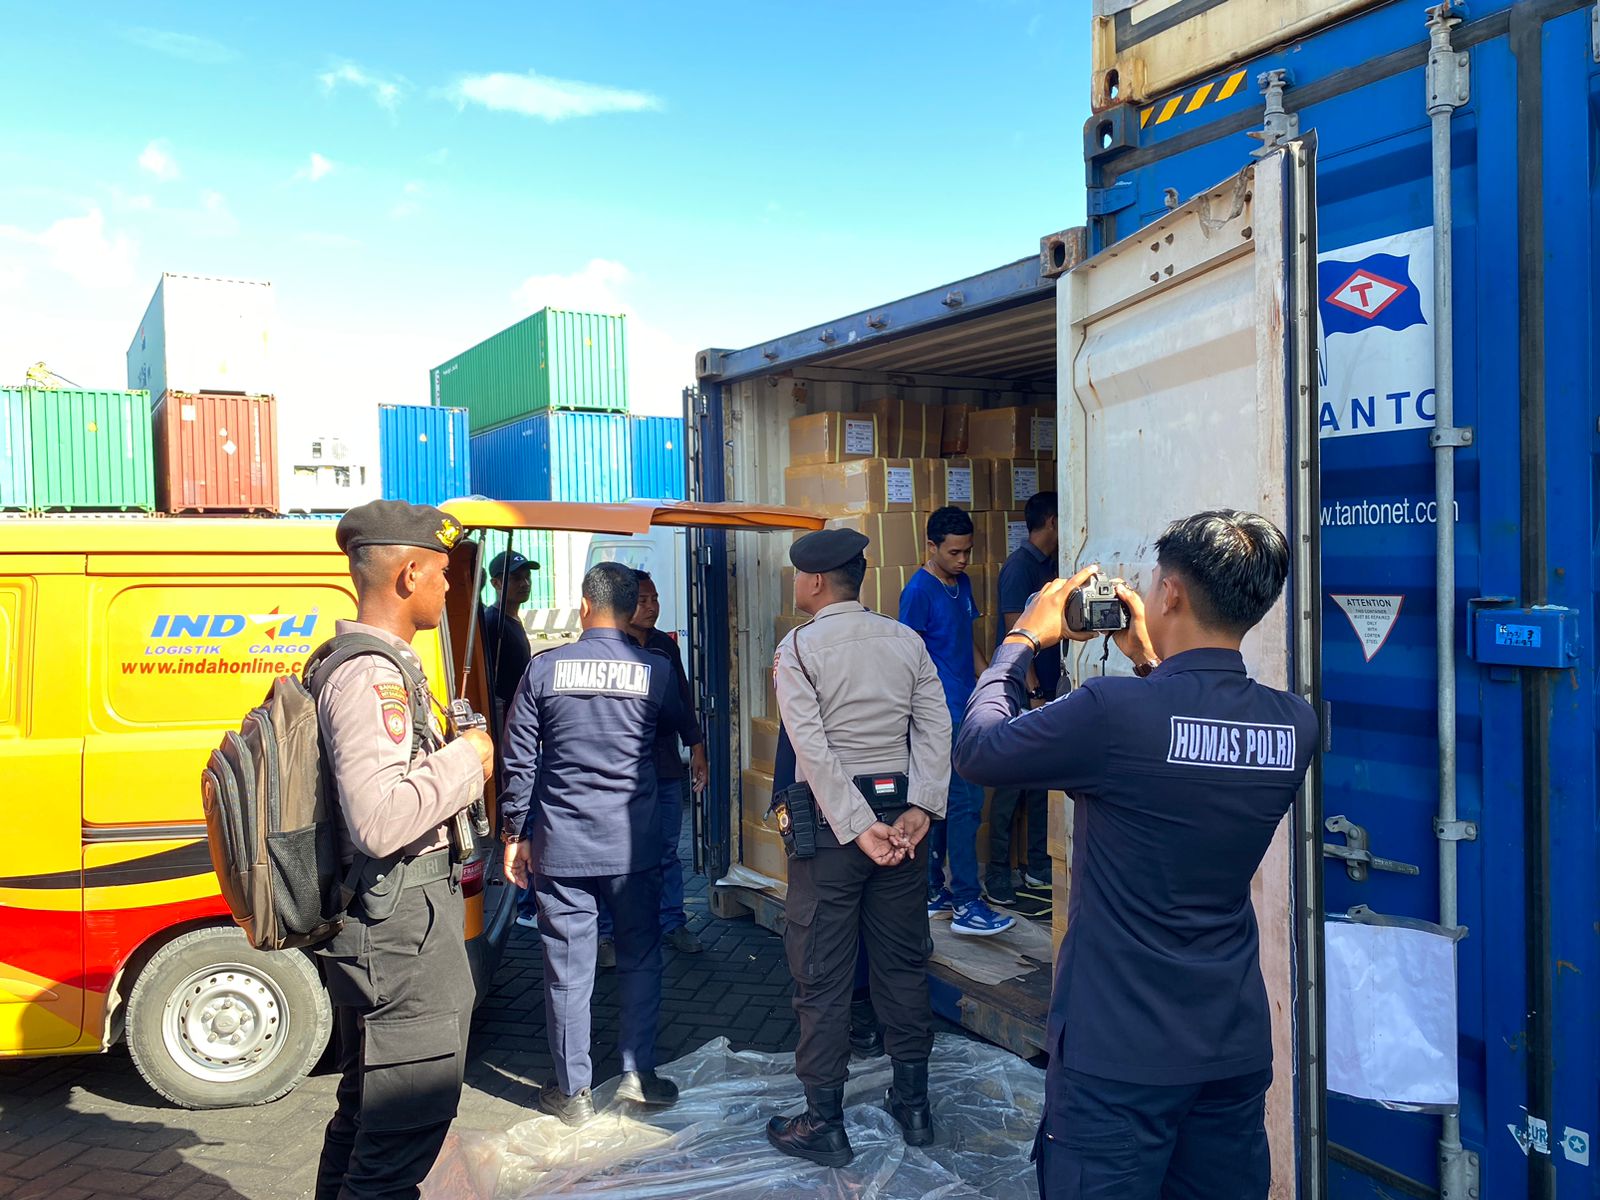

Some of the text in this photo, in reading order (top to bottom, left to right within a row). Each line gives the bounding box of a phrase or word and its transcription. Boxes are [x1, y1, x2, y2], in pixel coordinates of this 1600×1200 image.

[1350, 282, 1373, 307] T
[1319, 388, 1436, 433] ANTO
[1320, 498, 1459, 526] w.tantonet.co
[1346, 598, 1392, 608] ATTENTION
[144, 644, 311, 655] LOGISTIK CARGO
[121, 658, 302, 674] www.indahonline.c
[557, 661, 648, 692] HUMAS POLRI
[1174, 722, 1292, 766] HUMAS POLRI
